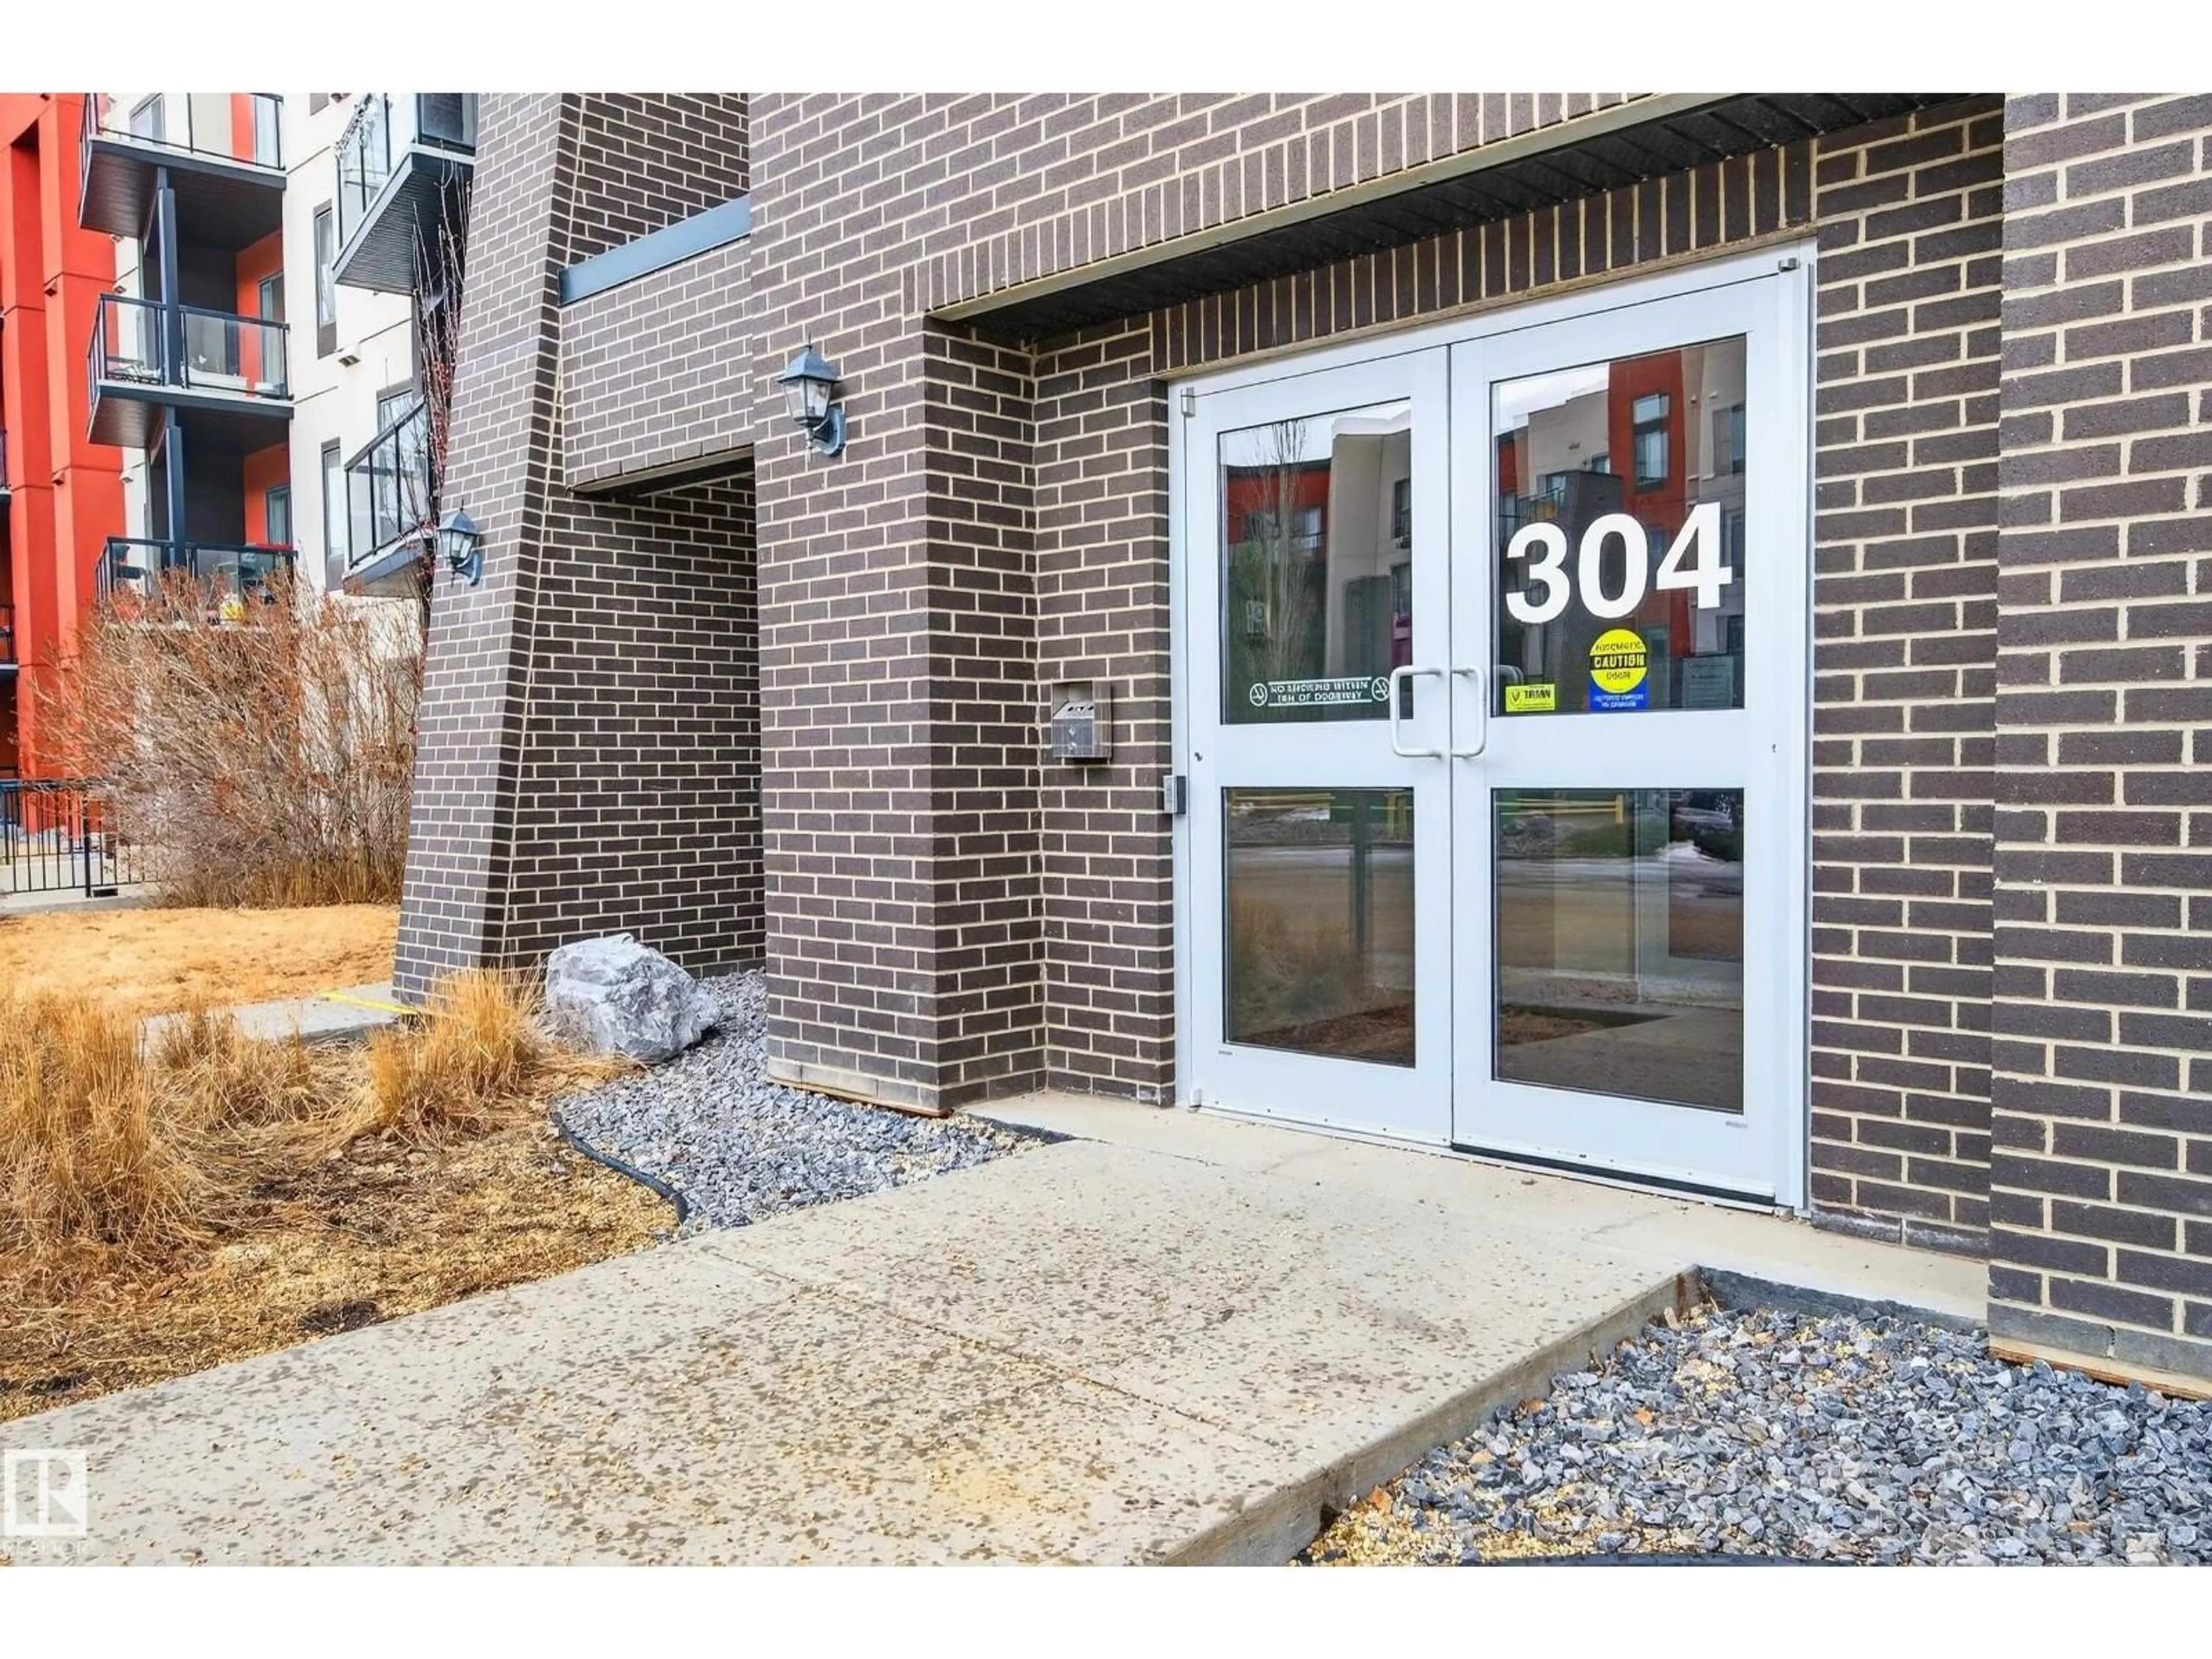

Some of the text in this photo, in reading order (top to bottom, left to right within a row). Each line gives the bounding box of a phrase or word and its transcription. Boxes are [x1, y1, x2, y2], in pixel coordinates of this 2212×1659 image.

[1505, 501, 1732, 624] 304
[1594, 654, 1645, 668] CAUTION
[1270, 685, 1285, 694] NO
[1298, 692, 1312, 702] OF
